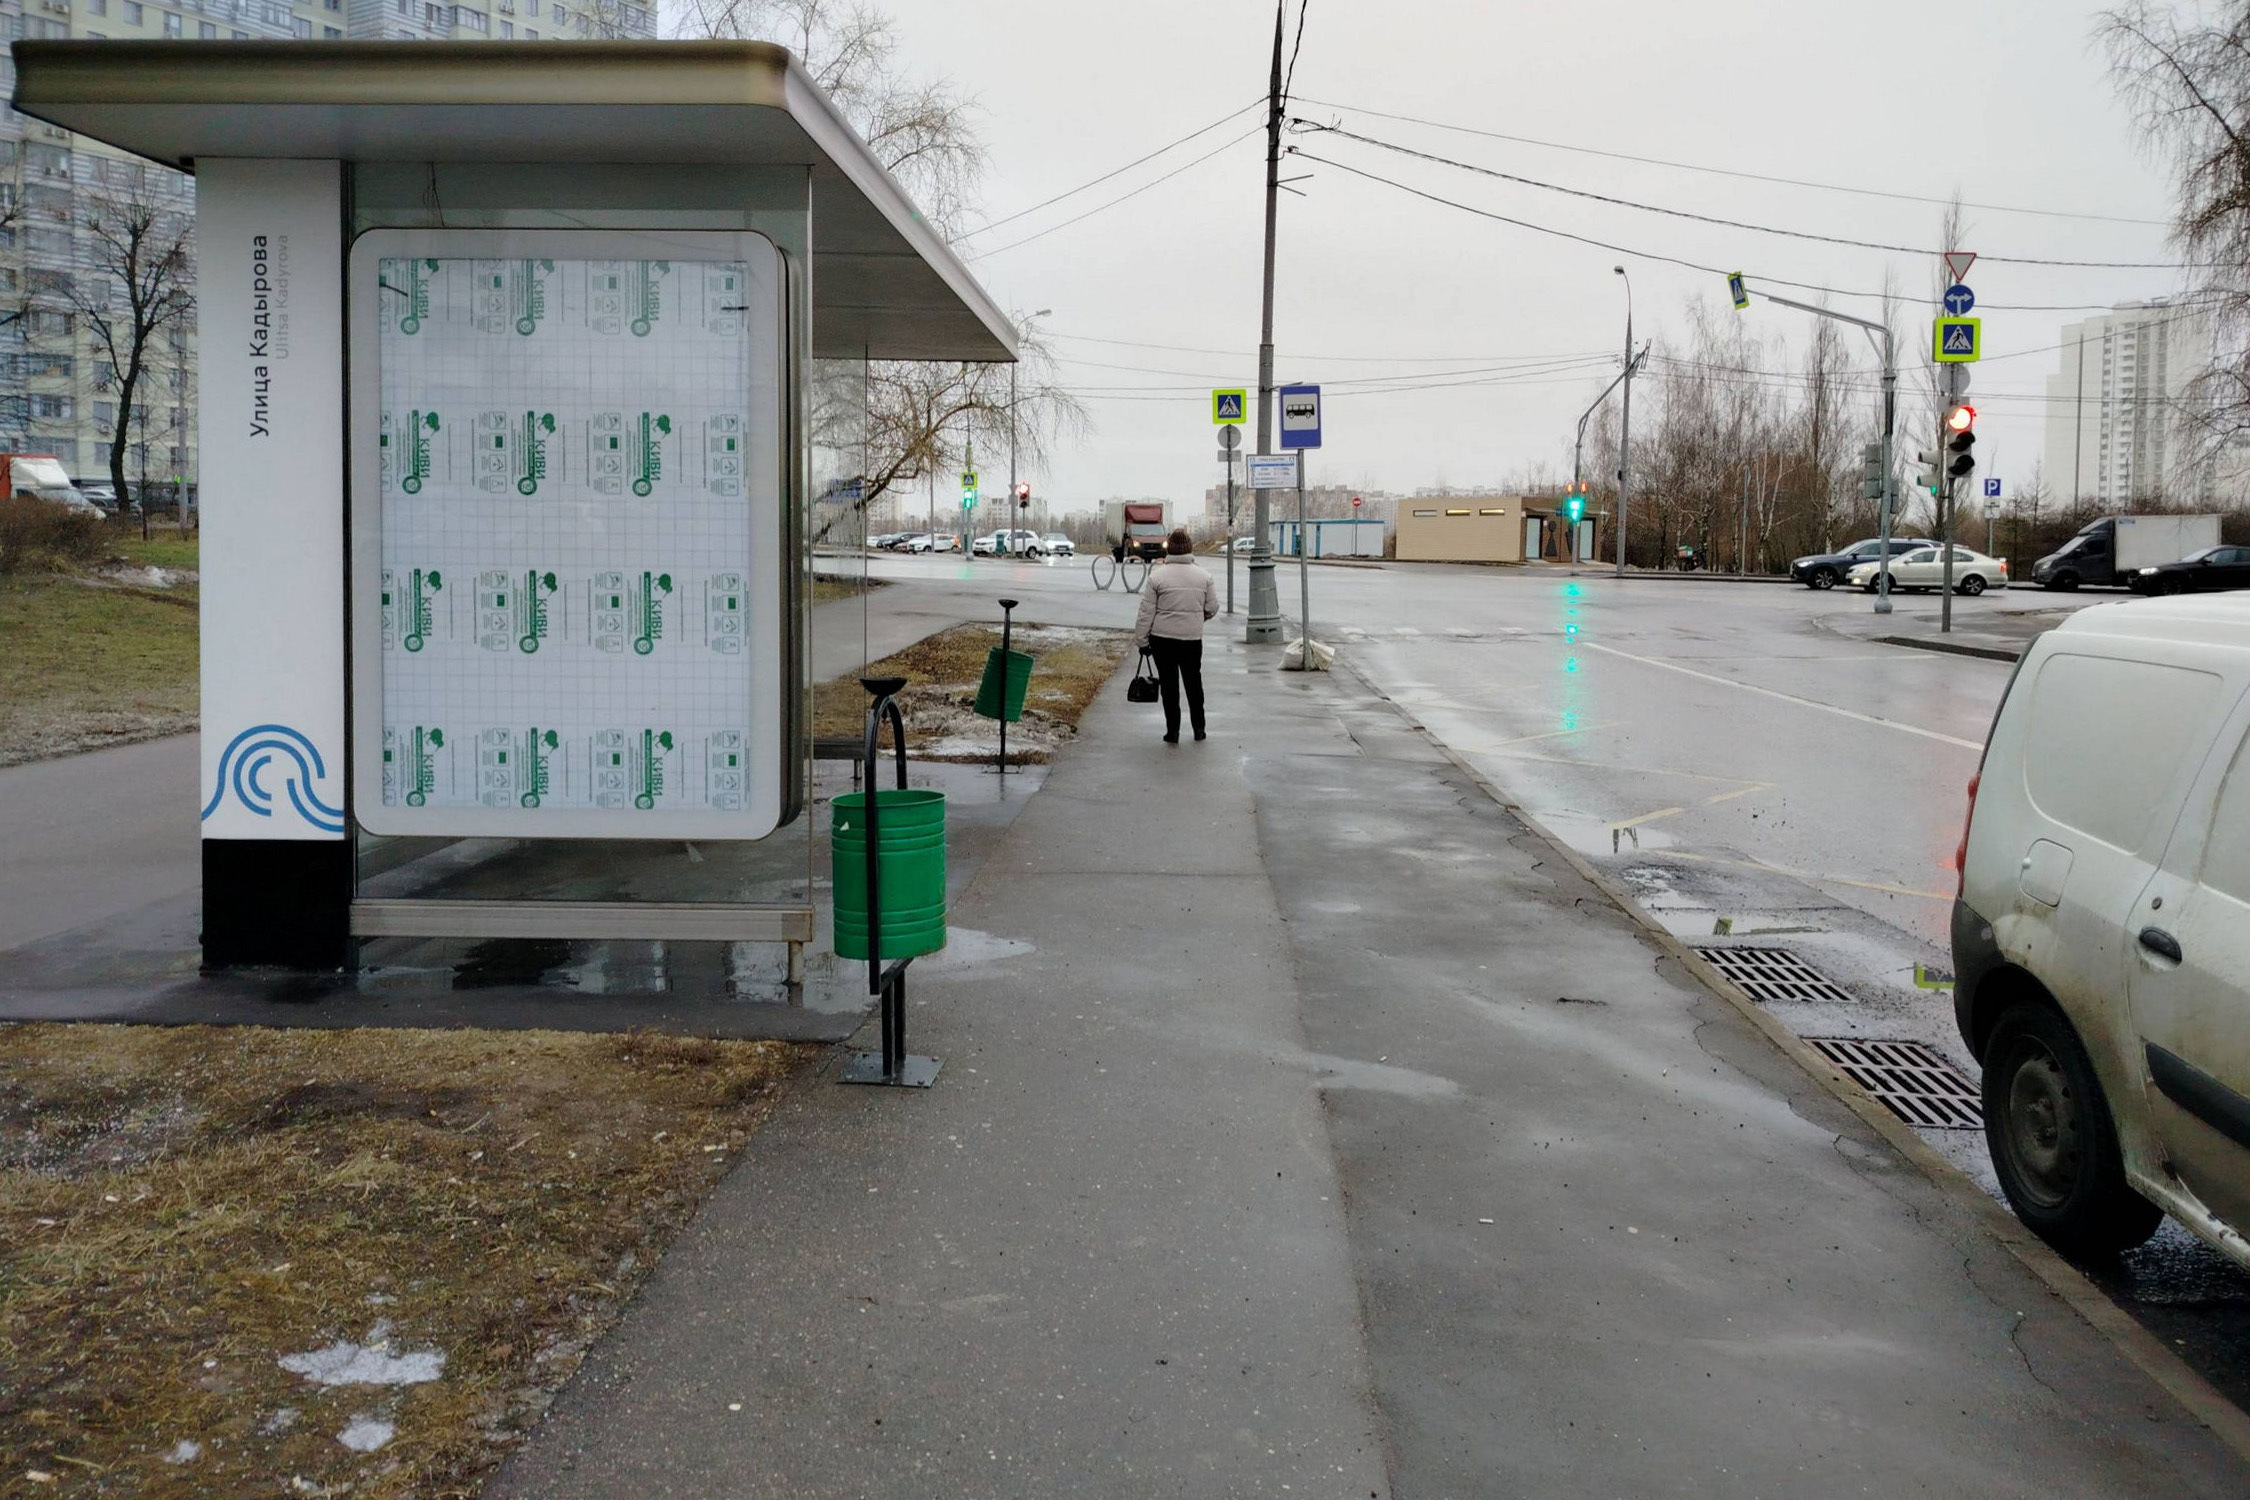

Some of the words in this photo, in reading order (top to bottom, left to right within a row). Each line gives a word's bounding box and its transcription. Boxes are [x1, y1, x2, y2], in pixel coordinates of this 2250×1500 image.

[275, 234, 291, 309] Kadyrova
[249, 235, 272, 357] Кадырова
[418, 278, 430, 320] КИВИ
[533, 279, 545, 320] КИВИ
[648, 281, 660, 321] КИВИ
[275, 314, 289, 360] Ulitsa
[250, 365, 271, 437] Улица
[419, 438, 430, 478] КИВИ
[534, 439, 546, 480] КИВИ
[649, 441, 661, 481] КИВИ
[1988, 480, 1998, 495] P
[421, 596, 433, 637] КИВИ
[535, 598, 548, 638] КИВИ
[650, 599, 662, 640] КИВИ
[421, 753, 434, 793] КИВИ
[537, 755, 549, 795] КИВИ
[651, 756, 663, 796] КИВИ
